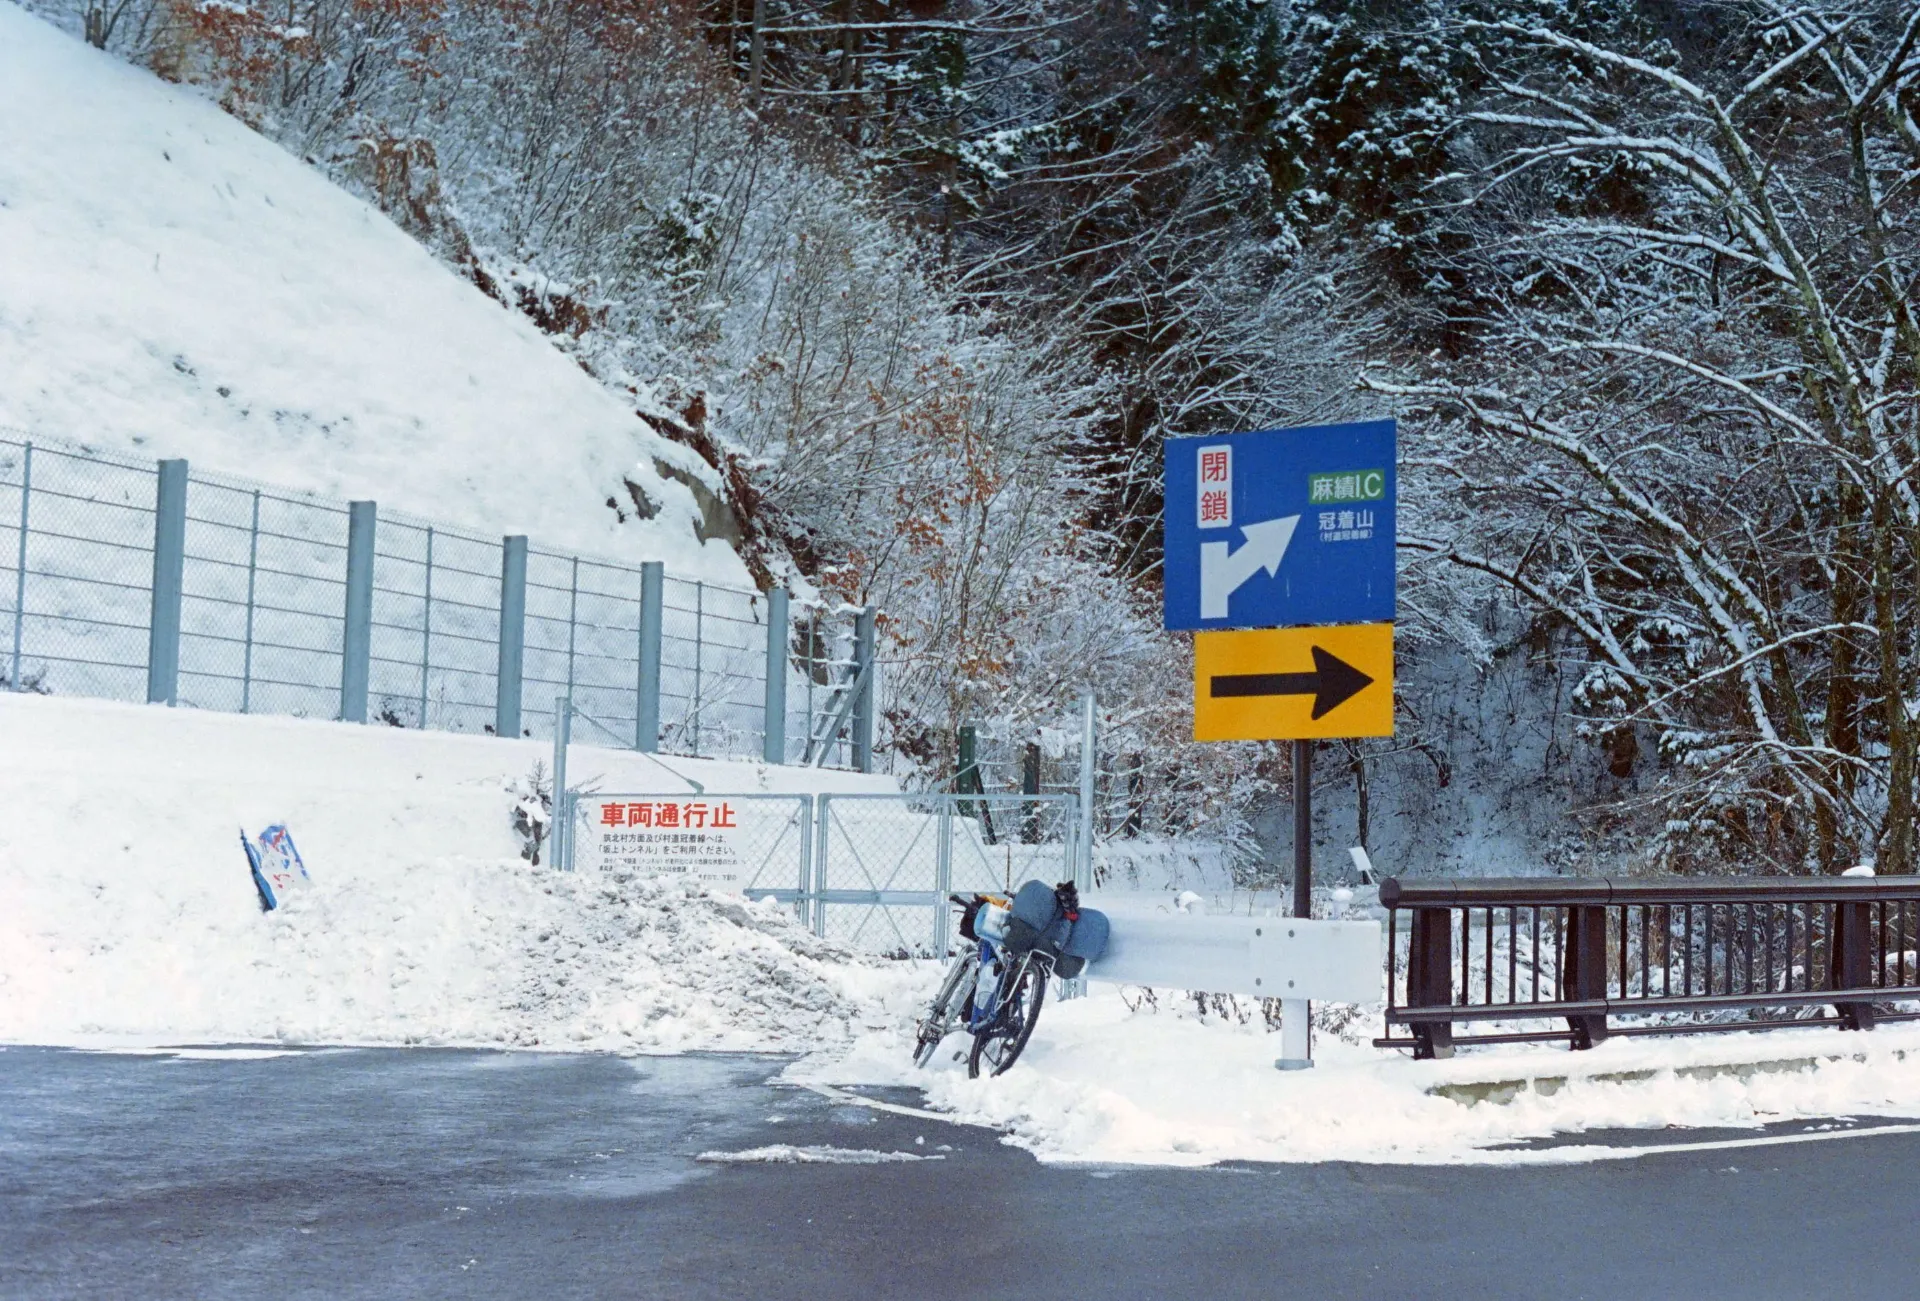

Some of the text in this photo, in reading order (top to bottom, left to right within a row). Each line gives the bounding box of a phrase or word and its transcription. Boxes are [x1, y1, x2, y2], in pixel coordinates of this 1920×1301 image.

[1201, 452, 1228, 521] 閉鎖
[1318, 509, 1374, 530] 冠着山
[600, 802, 737, 828] 車両通行止
